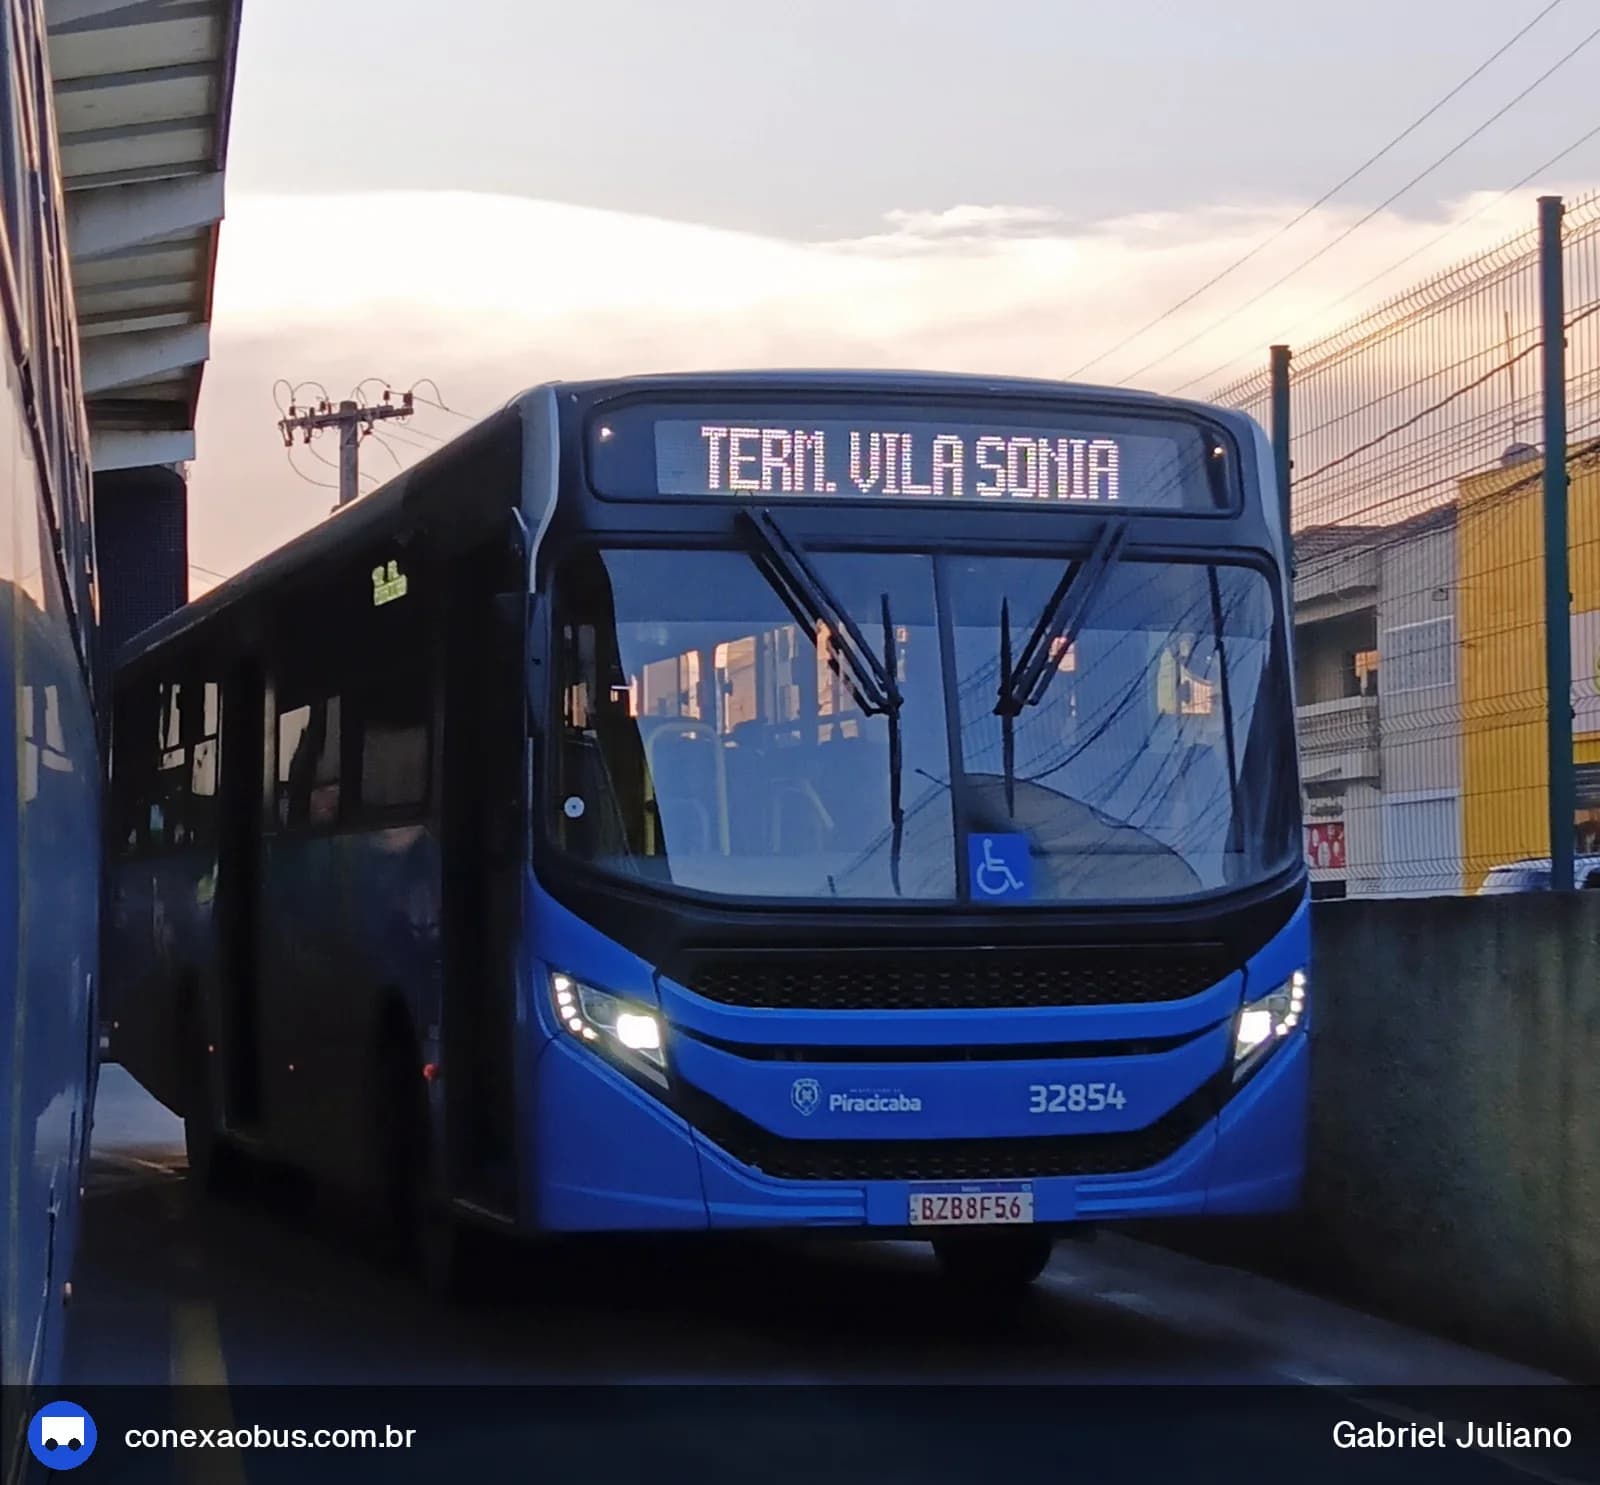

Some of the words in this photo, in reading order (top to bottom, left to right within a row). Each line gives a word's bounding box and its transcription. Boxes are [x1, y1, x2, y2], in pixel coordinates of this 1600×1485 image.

[701, 426, 837, 493] TERM.
[849, 431, 964, 496] VILA
[976, 436, 1119, 500] SONIA
[830, 1093, 922, 1112] Piracicaba
[1029, 1083, 1127, 1114] 32854
[921, 1196, 1021, 1221] BZB8F56
